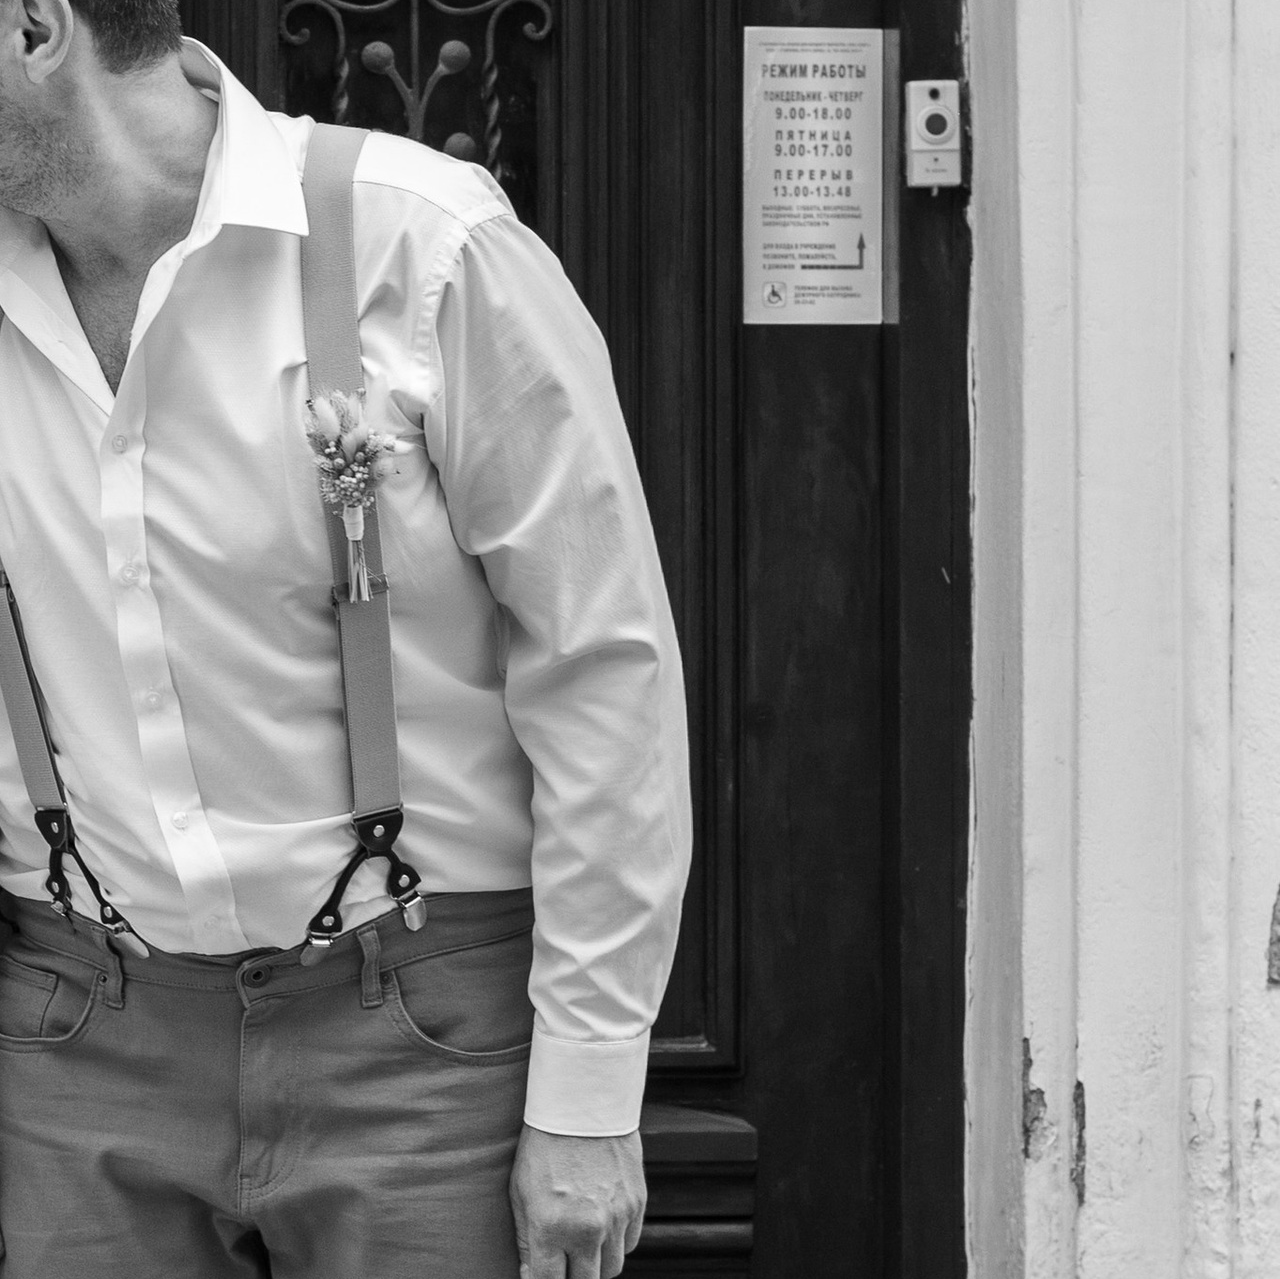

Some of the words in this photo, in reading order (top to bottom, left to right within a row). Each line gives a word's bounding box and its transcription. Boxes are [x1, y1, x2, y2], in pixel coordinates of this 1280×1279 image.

[761, 64, 808, 78] РЕЖИМ
[812, 64, 867, 79] РАБОТЫ
[775, 107, 852, 120] 9.00-18.00
[775, 130, 852, 141] ПЯТНИЦА
[774, 144, 852, 157] 9.00-17.00
[773, 169, 853, 180] ПЕРЕРЫВ
[773, 186, 852, 197] 13.00-13.48
